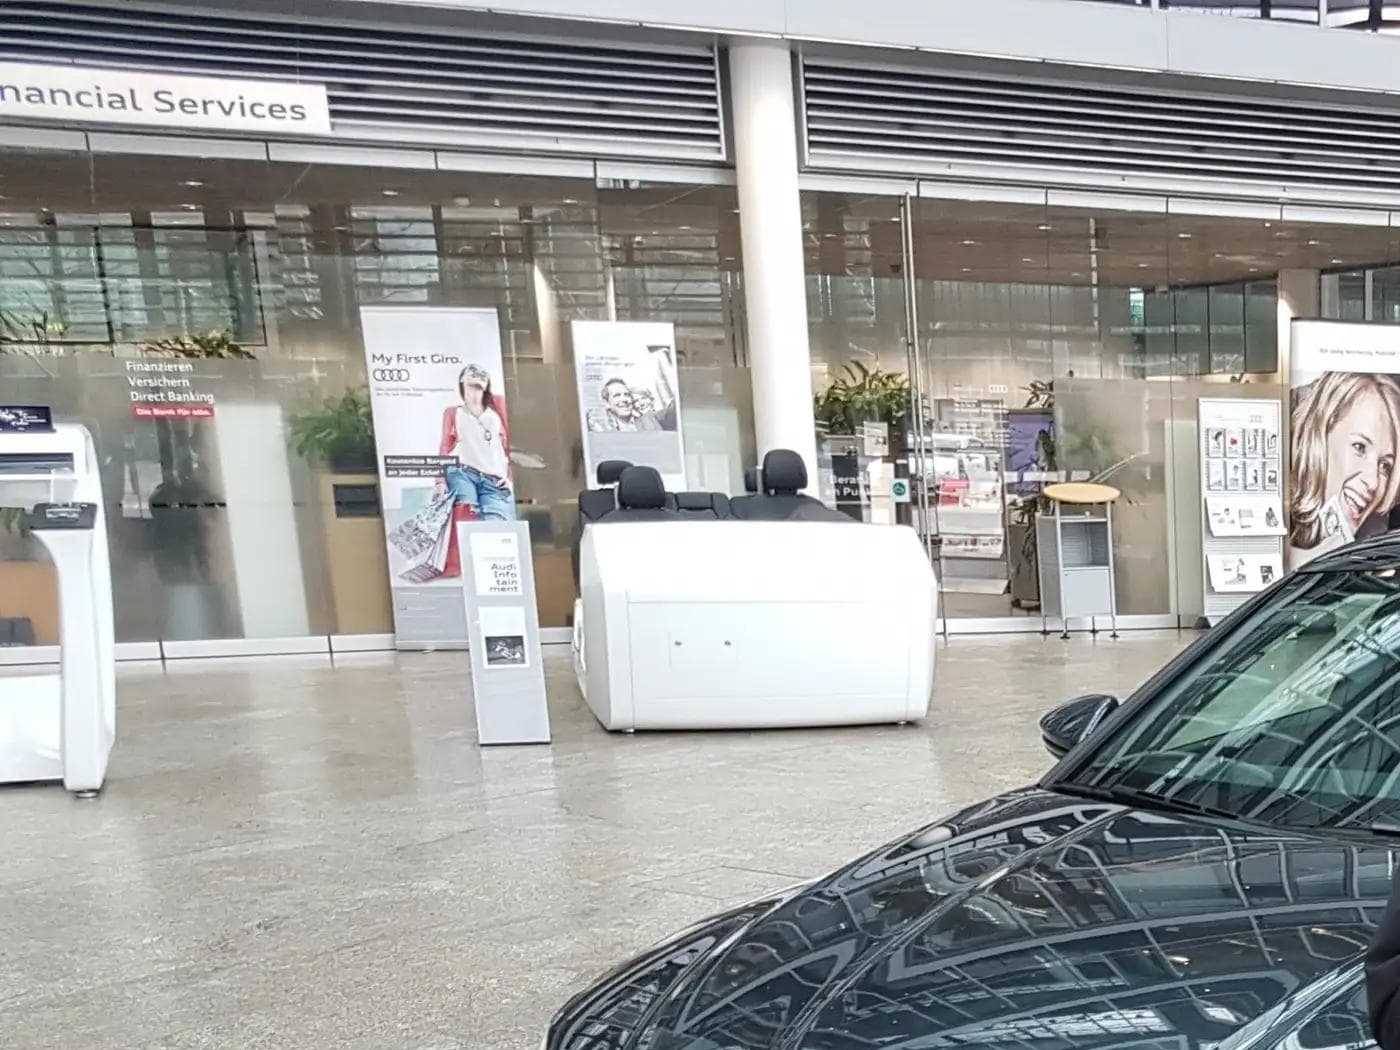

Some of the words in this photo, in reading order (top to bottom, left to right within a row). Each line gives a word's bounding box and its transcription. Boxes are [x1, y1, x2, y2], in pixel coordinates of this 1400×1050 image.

[0, 83, 143, 112] nancial
[154, 89, 307, 121] Services
[372, 353, 393, 366] My
[396, 353, 428, 364] First
[430, 354, 463, 364] Giro.
[126, 361, 193, 372] Finanzieren
[127, 375, 190, 387] Versichern
[130, 391, 166, 402] Direct
[168, 391, 214, 405] Banking
[490, 563, 517, 571] Audi
[493, 570, 518, 578] Info
[495, 578, 519, 586] tain
